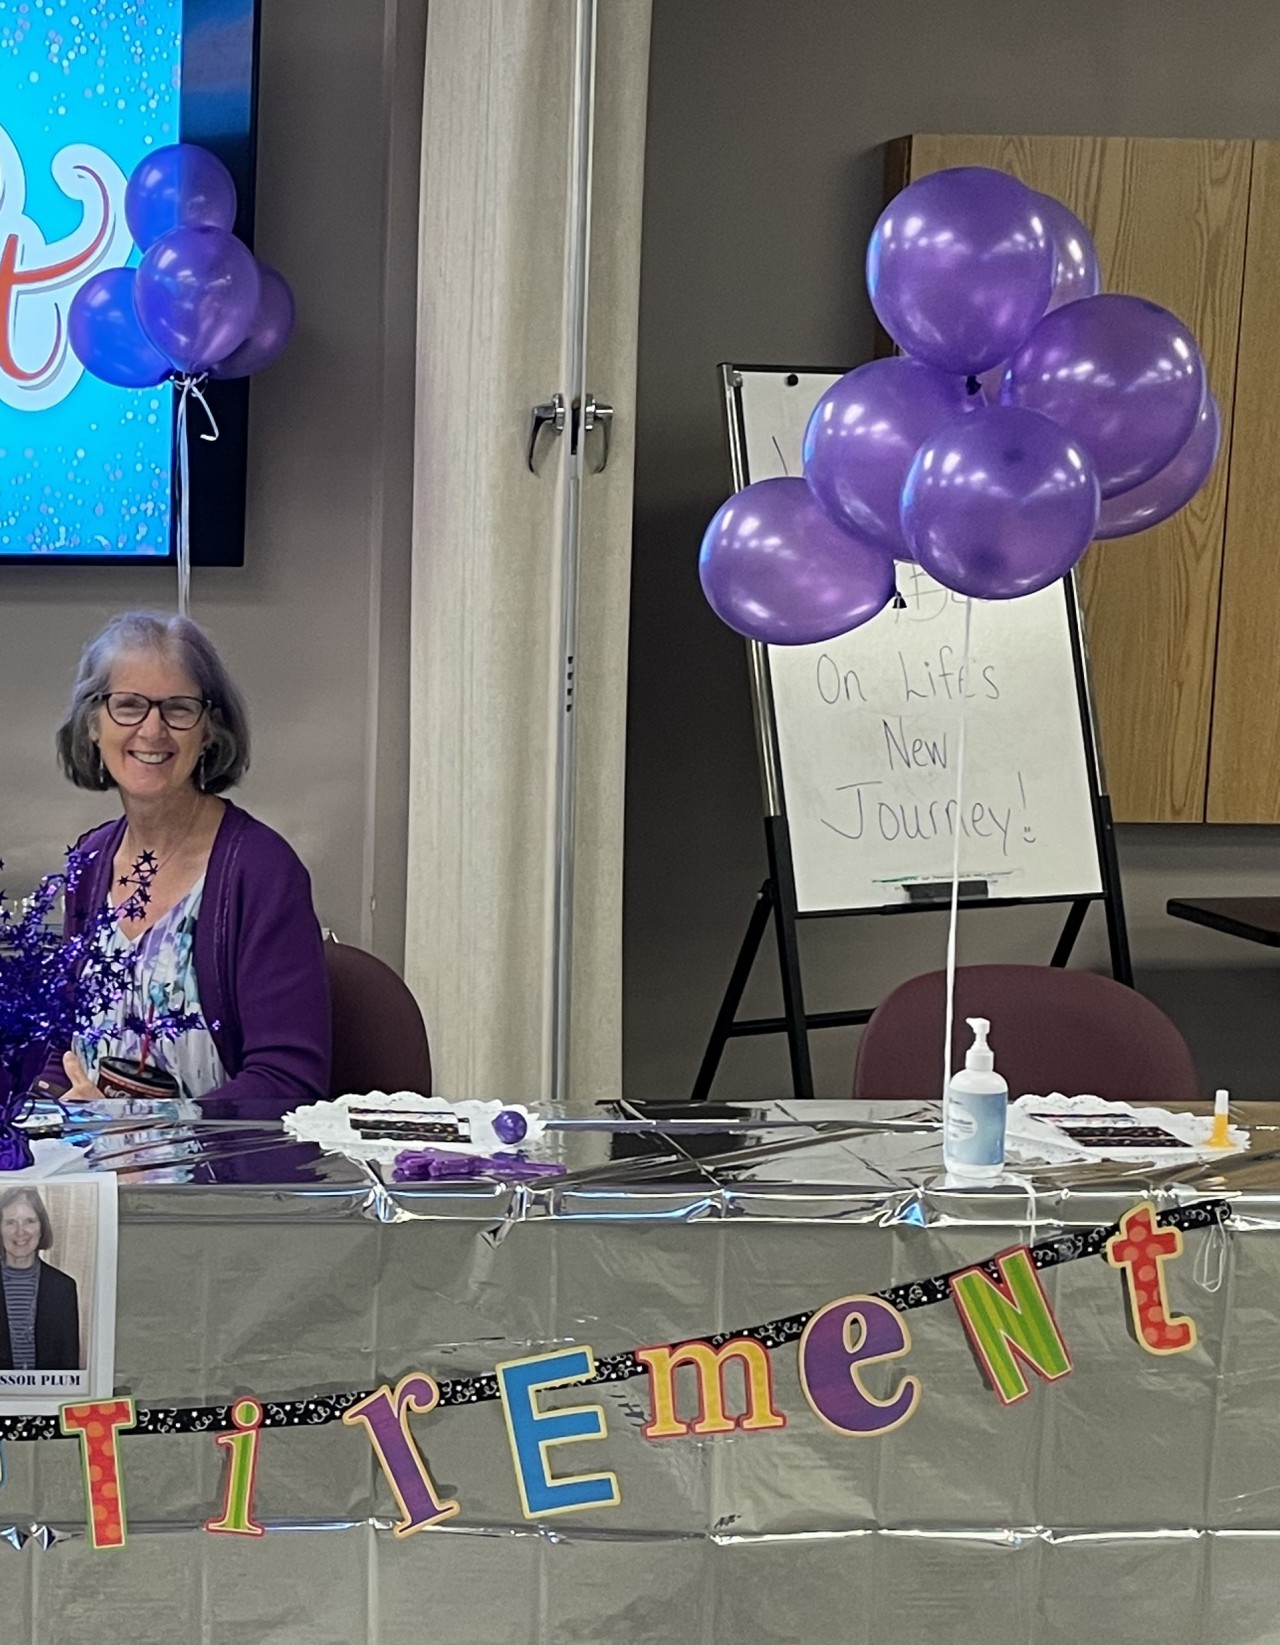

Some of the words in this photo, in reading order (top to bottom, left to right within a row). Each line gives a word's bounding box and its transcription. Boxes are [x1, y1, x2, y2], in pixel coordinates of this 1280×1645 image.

[816, 653, 868, 705] On
[883, 718, 948, 771] New
[821, 771, 1037, 857] Journey!
[41, 1374, 81, 1386] PLUM
